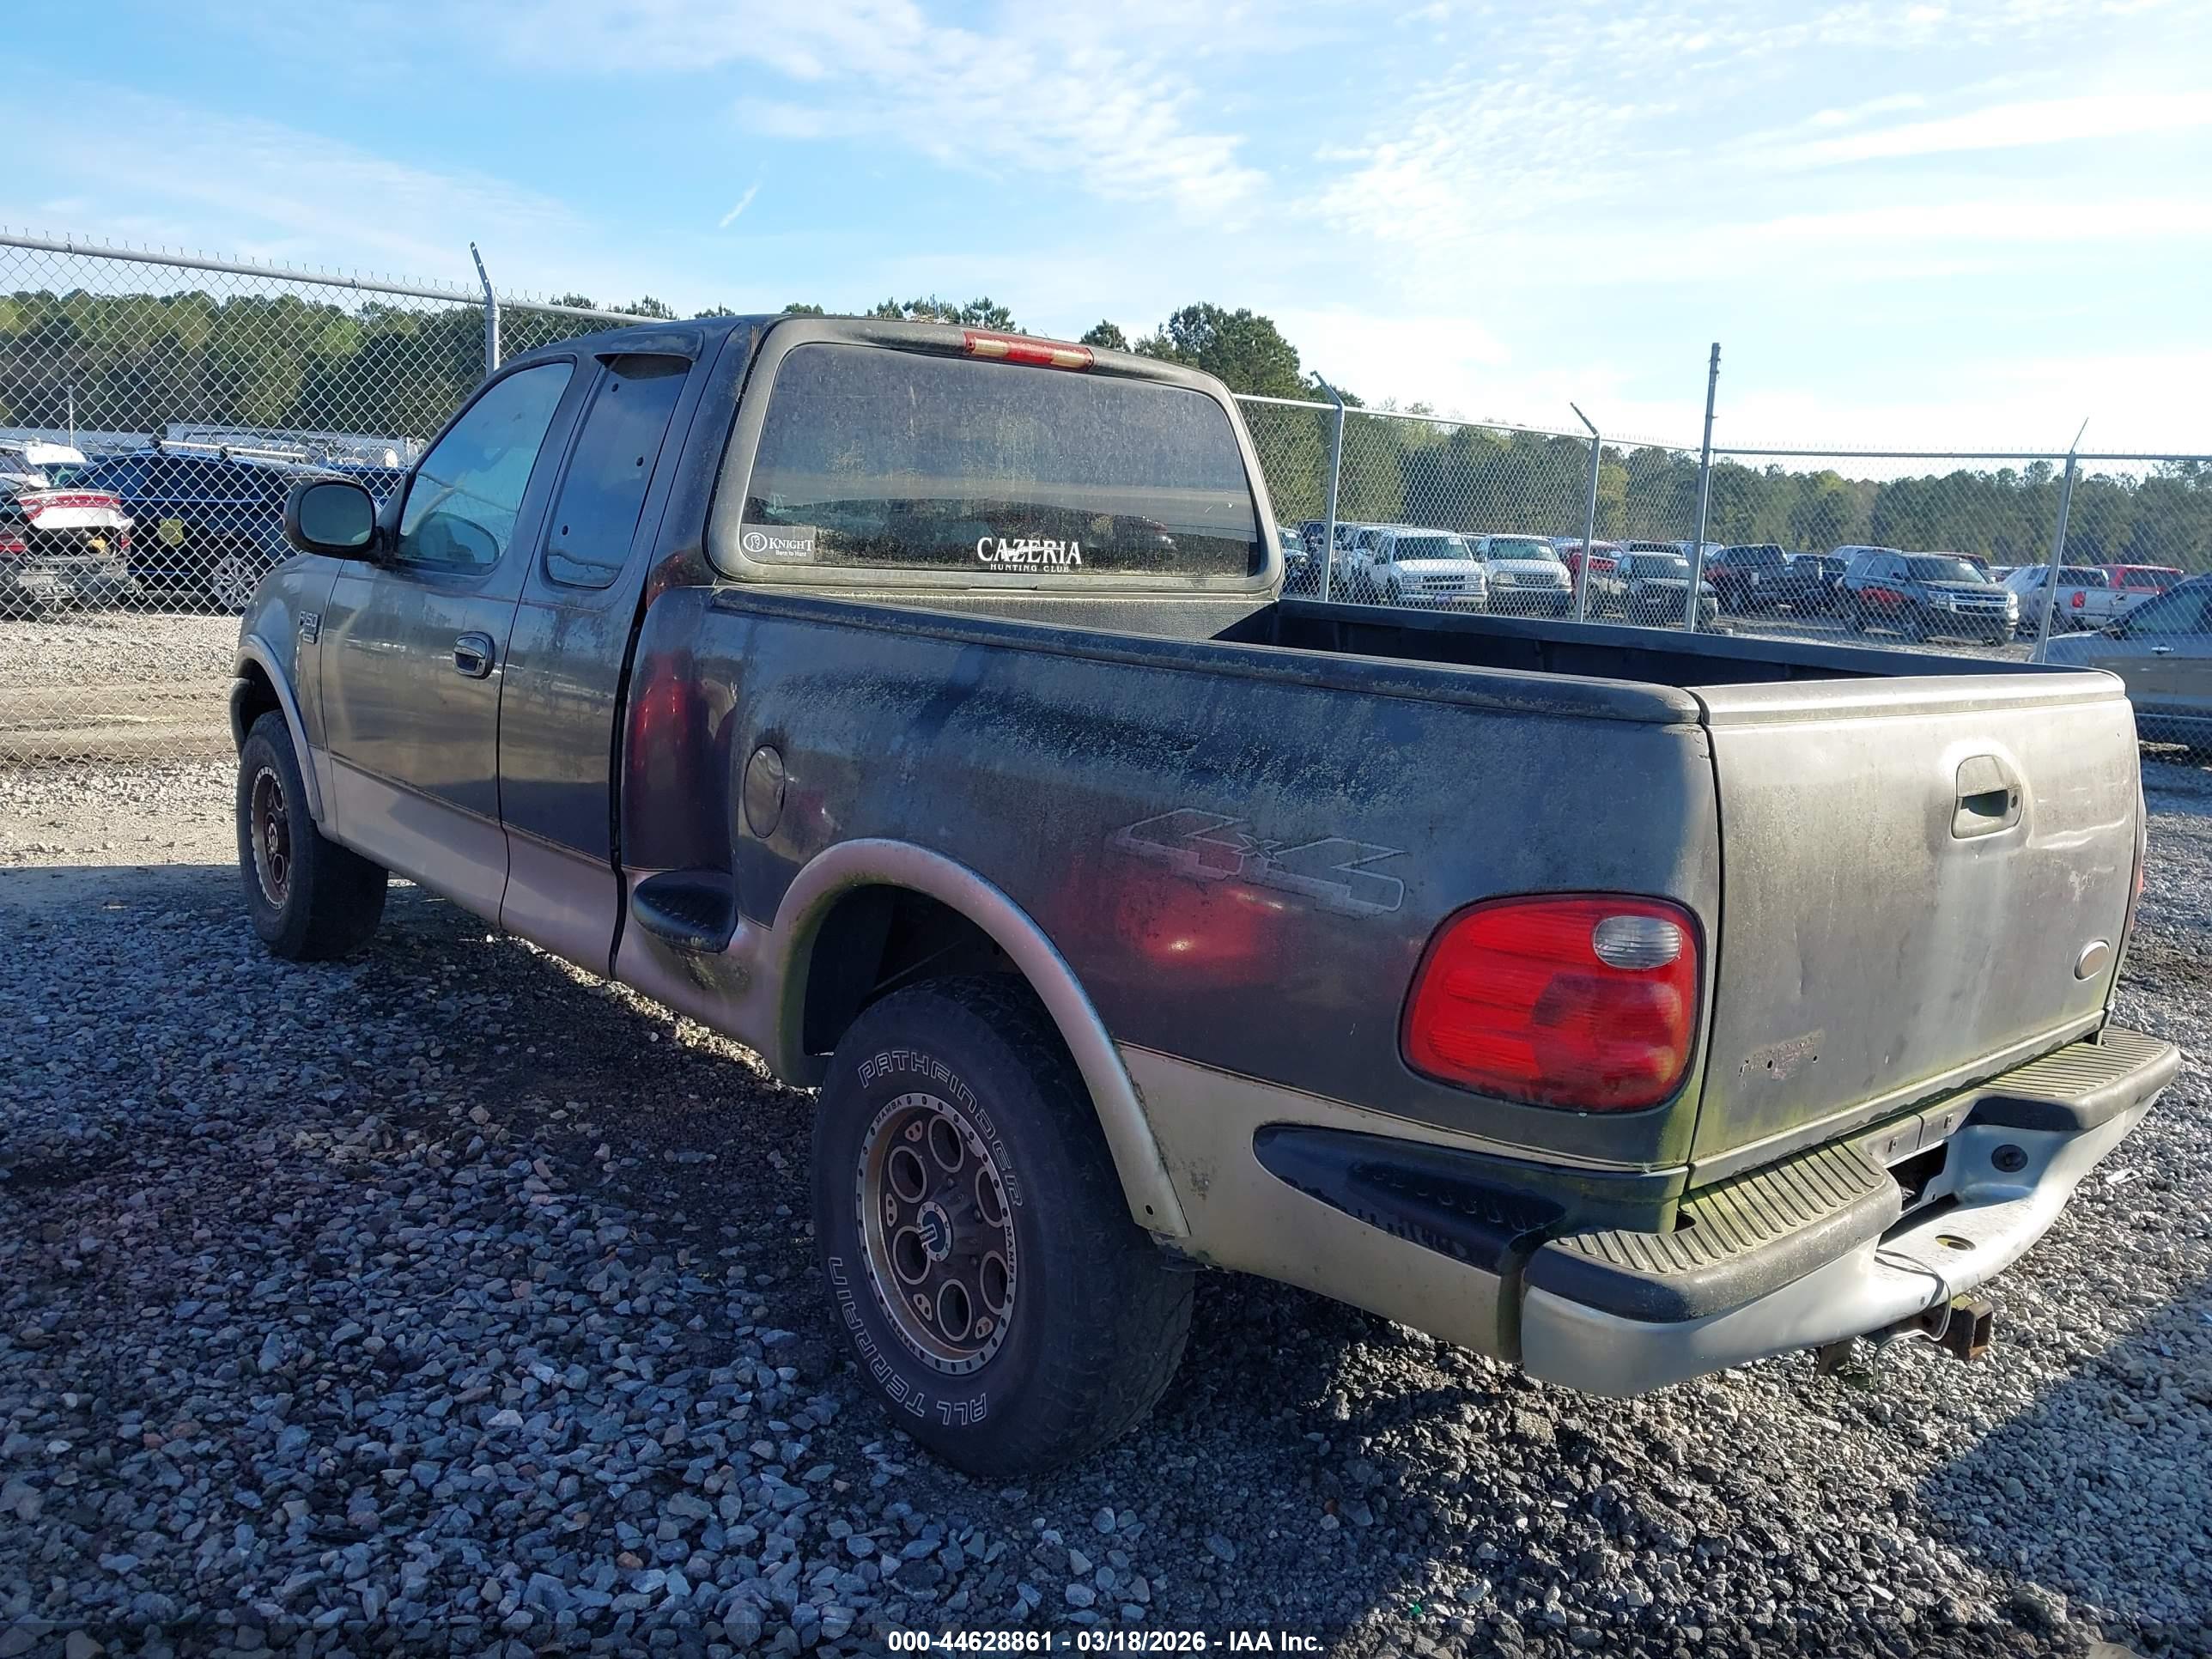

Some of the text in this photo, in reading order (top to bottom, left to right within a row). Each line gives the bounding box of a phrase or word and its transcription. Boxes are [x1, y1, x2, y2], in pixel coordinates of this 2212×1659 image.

[769, 537, 814, 551] KNIGHT
[976, 537, 1082, 565] CAZERIA
[990, 563, 1037, 572] HUNTING
[875, 1099, 902, 1126] MAMBA
[858, 1050, 1024, 1207] PATHFINDER
[828, 1256, 988, 1426] ALL TERRAIN
